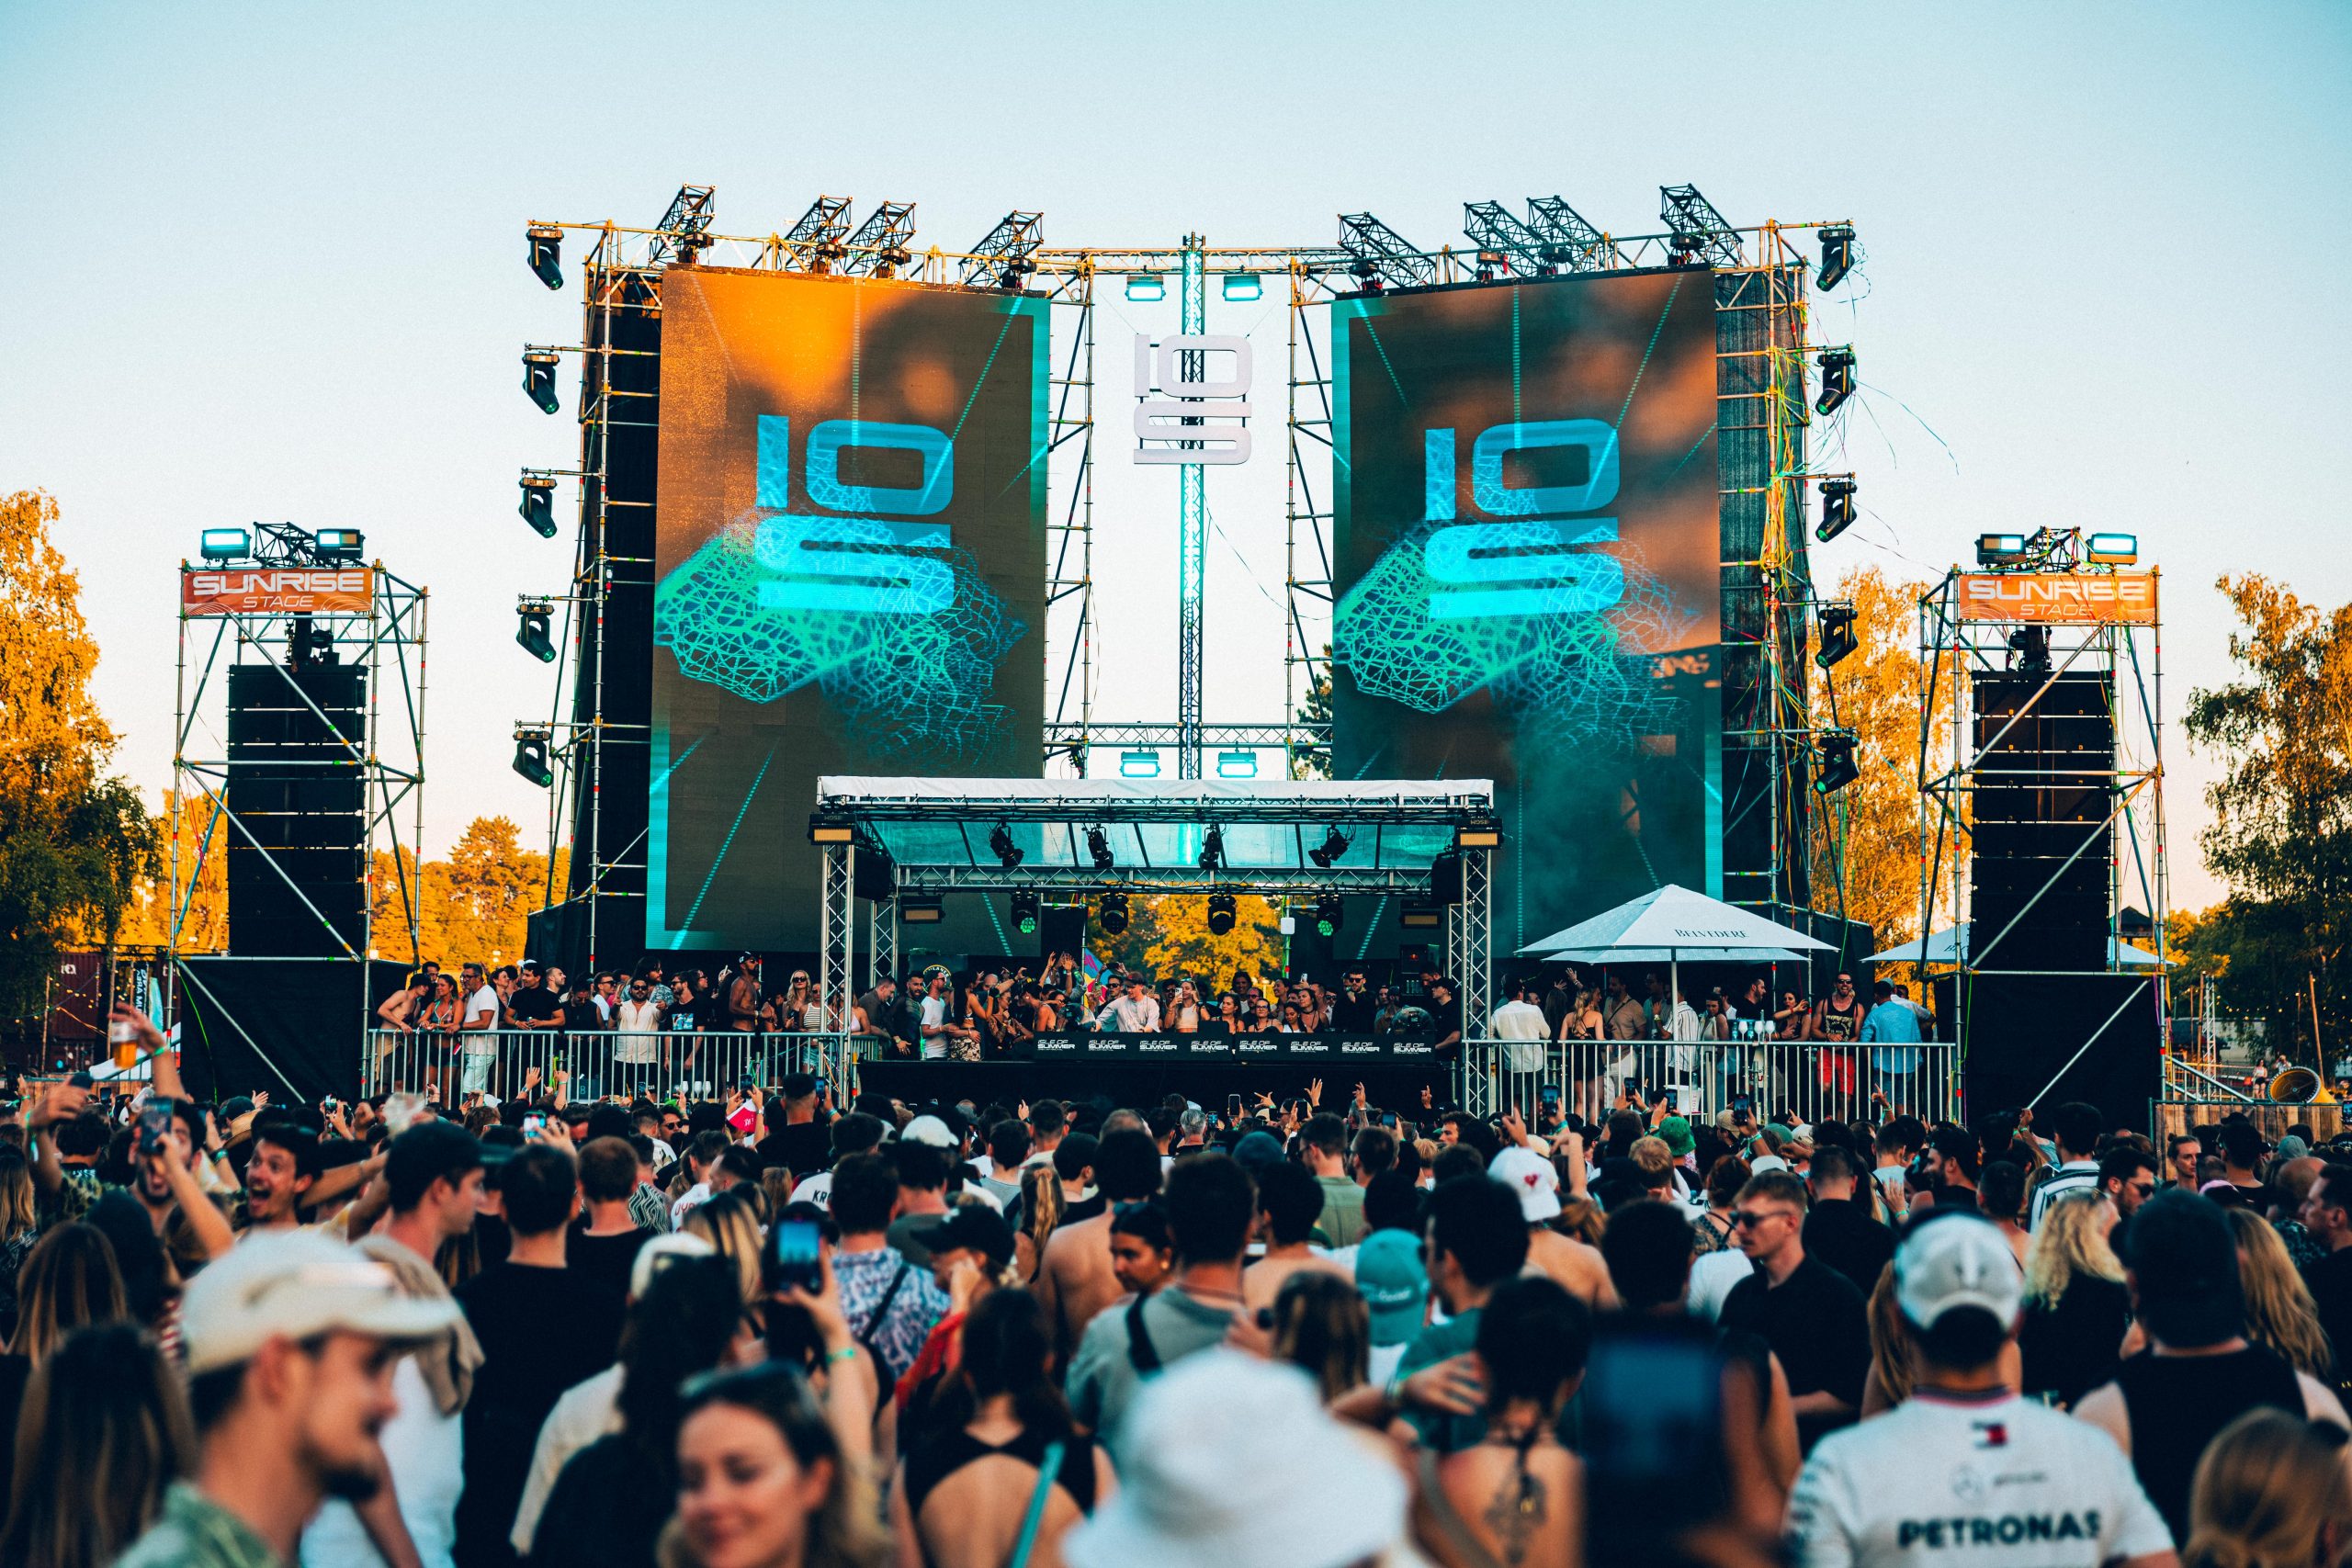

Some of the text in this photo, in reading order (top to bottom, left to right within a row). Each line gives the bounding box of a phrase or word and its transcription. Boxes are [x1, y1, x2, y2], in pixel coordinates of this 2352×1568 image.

[193, 572, 364, 596] SUNRISE
[1968, 580, 2146, 601] SUNRISE
[243, 595, 314, 609] STAGE
[2019, 604, 2094, 616] STAGE
[1674, 929, 1749, 938] BELVEDERE
[1897, 1510, 2101, 1550] PETRONAS
